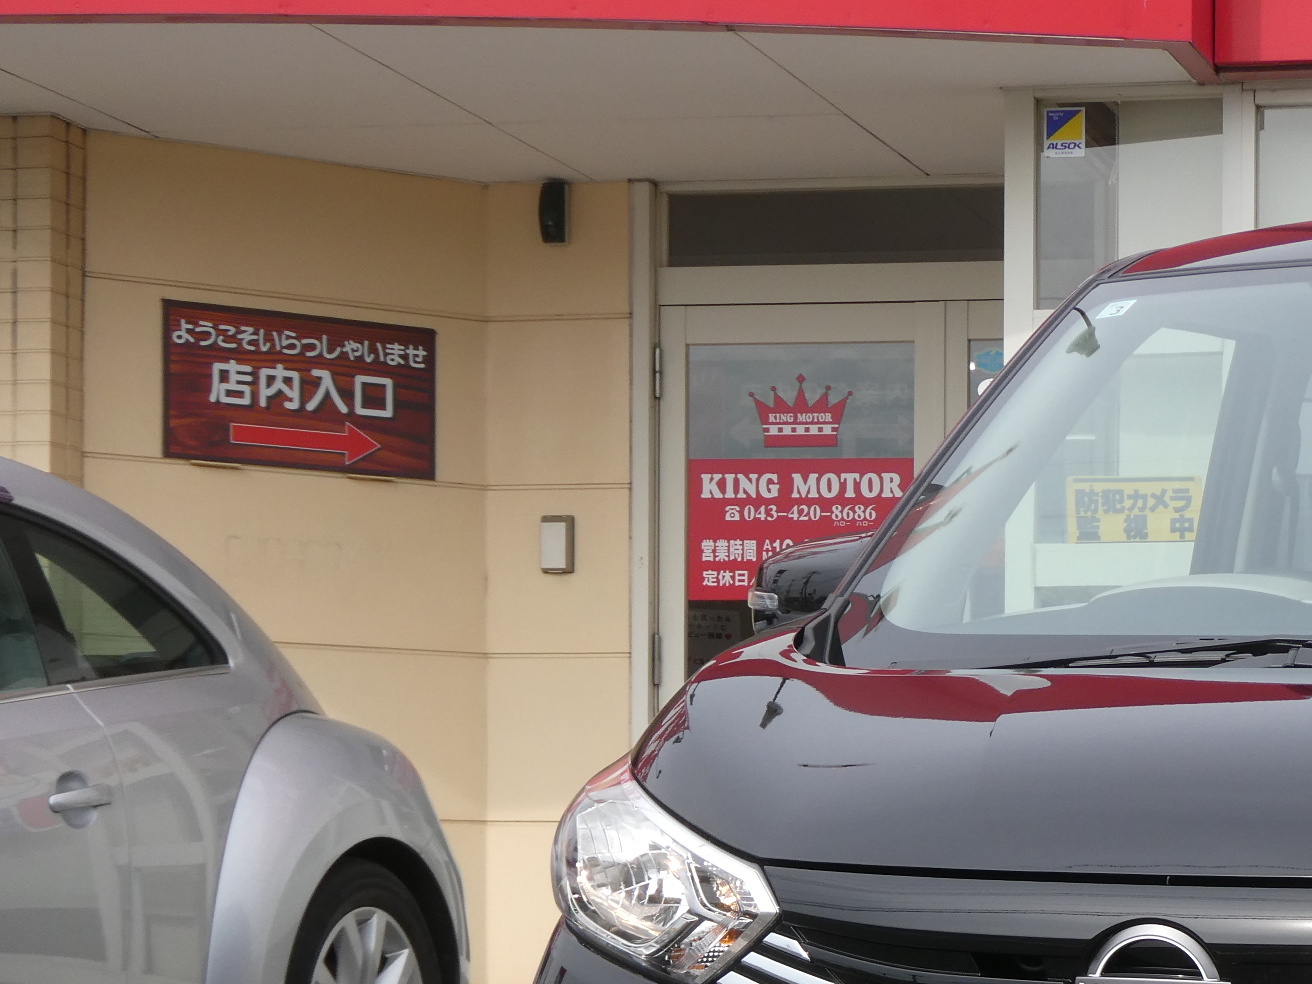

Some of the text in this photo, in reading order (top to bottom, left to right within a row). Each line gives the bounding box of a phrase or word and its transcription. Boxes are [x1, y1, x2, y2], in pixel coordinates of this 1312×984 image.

[1047, 142, 1083, 150] ALSOK
[171, 318, 428, 369] ようこそいらっしゃいませ
[209, 359, 395, 418] 店内入口
[768, 412, 832, 423] KING MOTOR
[700, 472, 904, 499] KING MOTOR
[743, 504, 877, 521] 043-420-8686
[1075, 488, 1192, 515] 防犯カメラ
[701, 539, 756, 562] 営業時間
